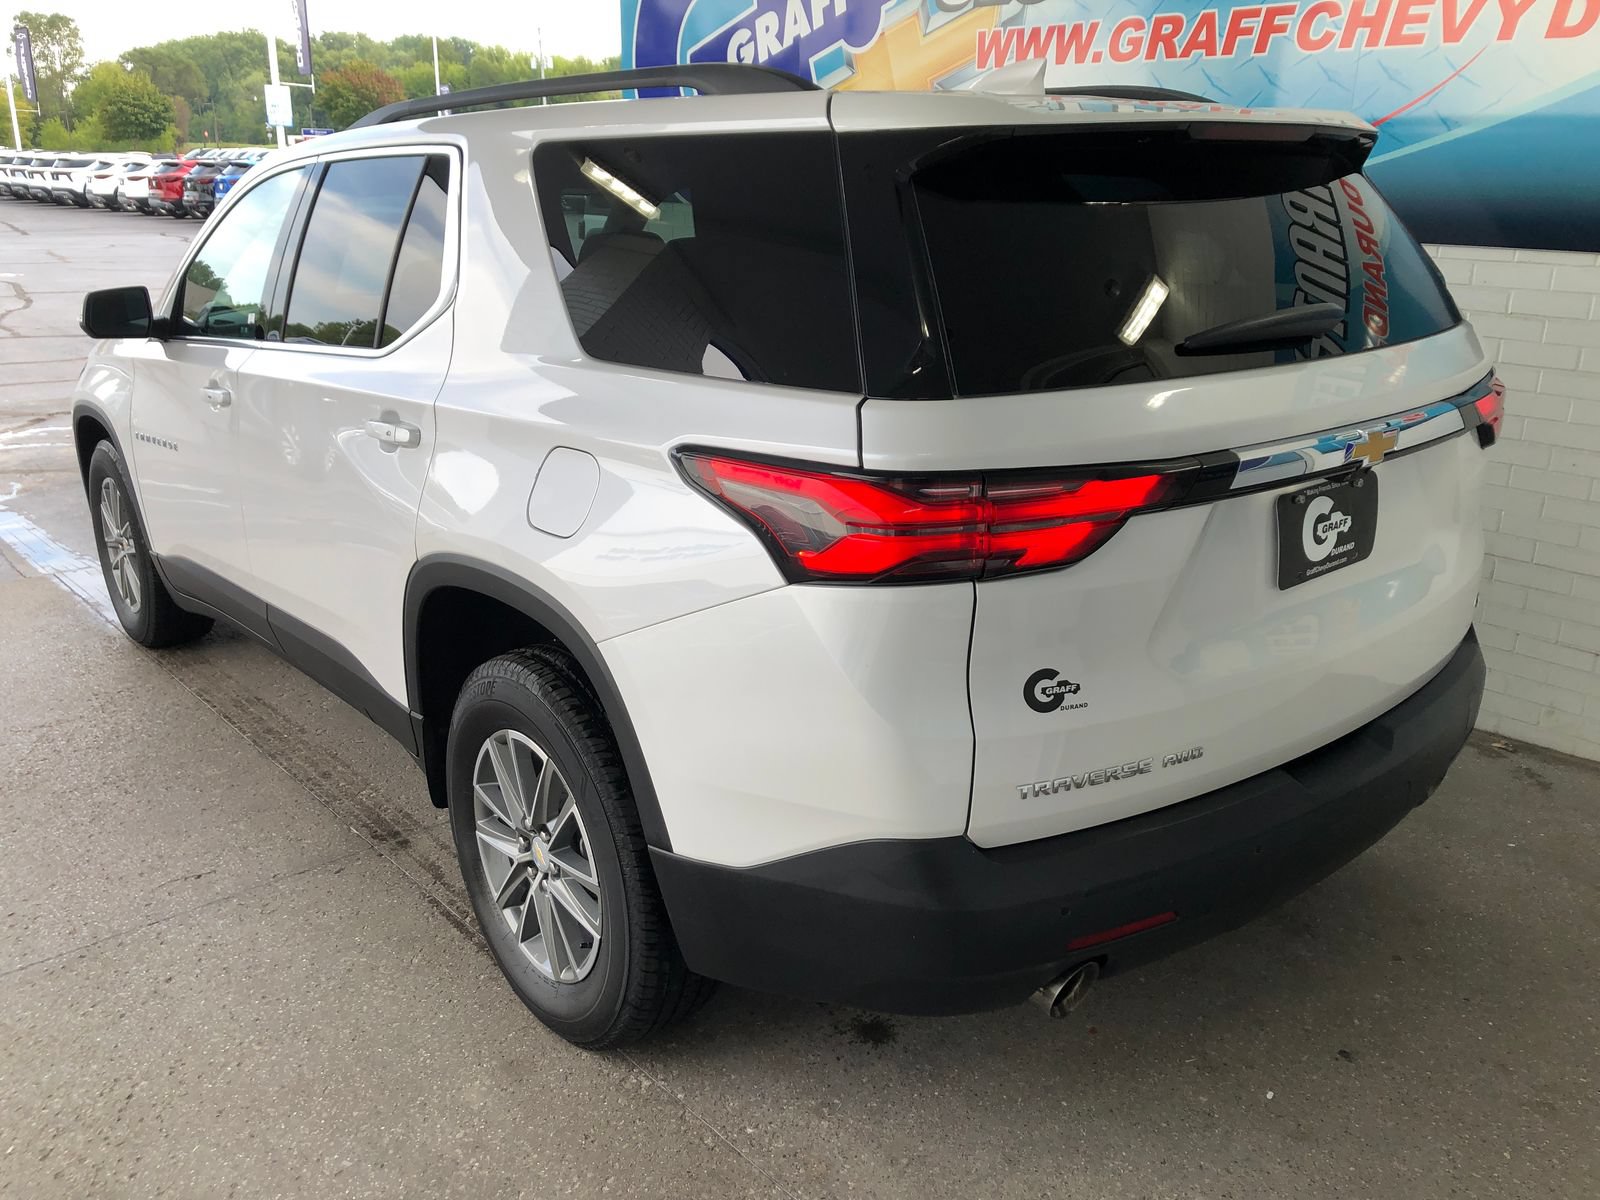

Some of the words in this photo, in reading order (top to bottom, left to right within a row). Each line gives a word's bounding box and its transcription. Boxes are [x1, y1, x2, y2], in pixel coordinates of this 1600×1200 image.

[1321, 517, 1349, 534] GRAFF
[1330, 542, 1355, 557] DURAND
[1045, 684, 1078, 695] GRAFF
[1060, 702, 1089, 711] DURAND
[1016, 758, 1153, 800] TRAVERSE
[1162, 746, 1204, 768] AWD
